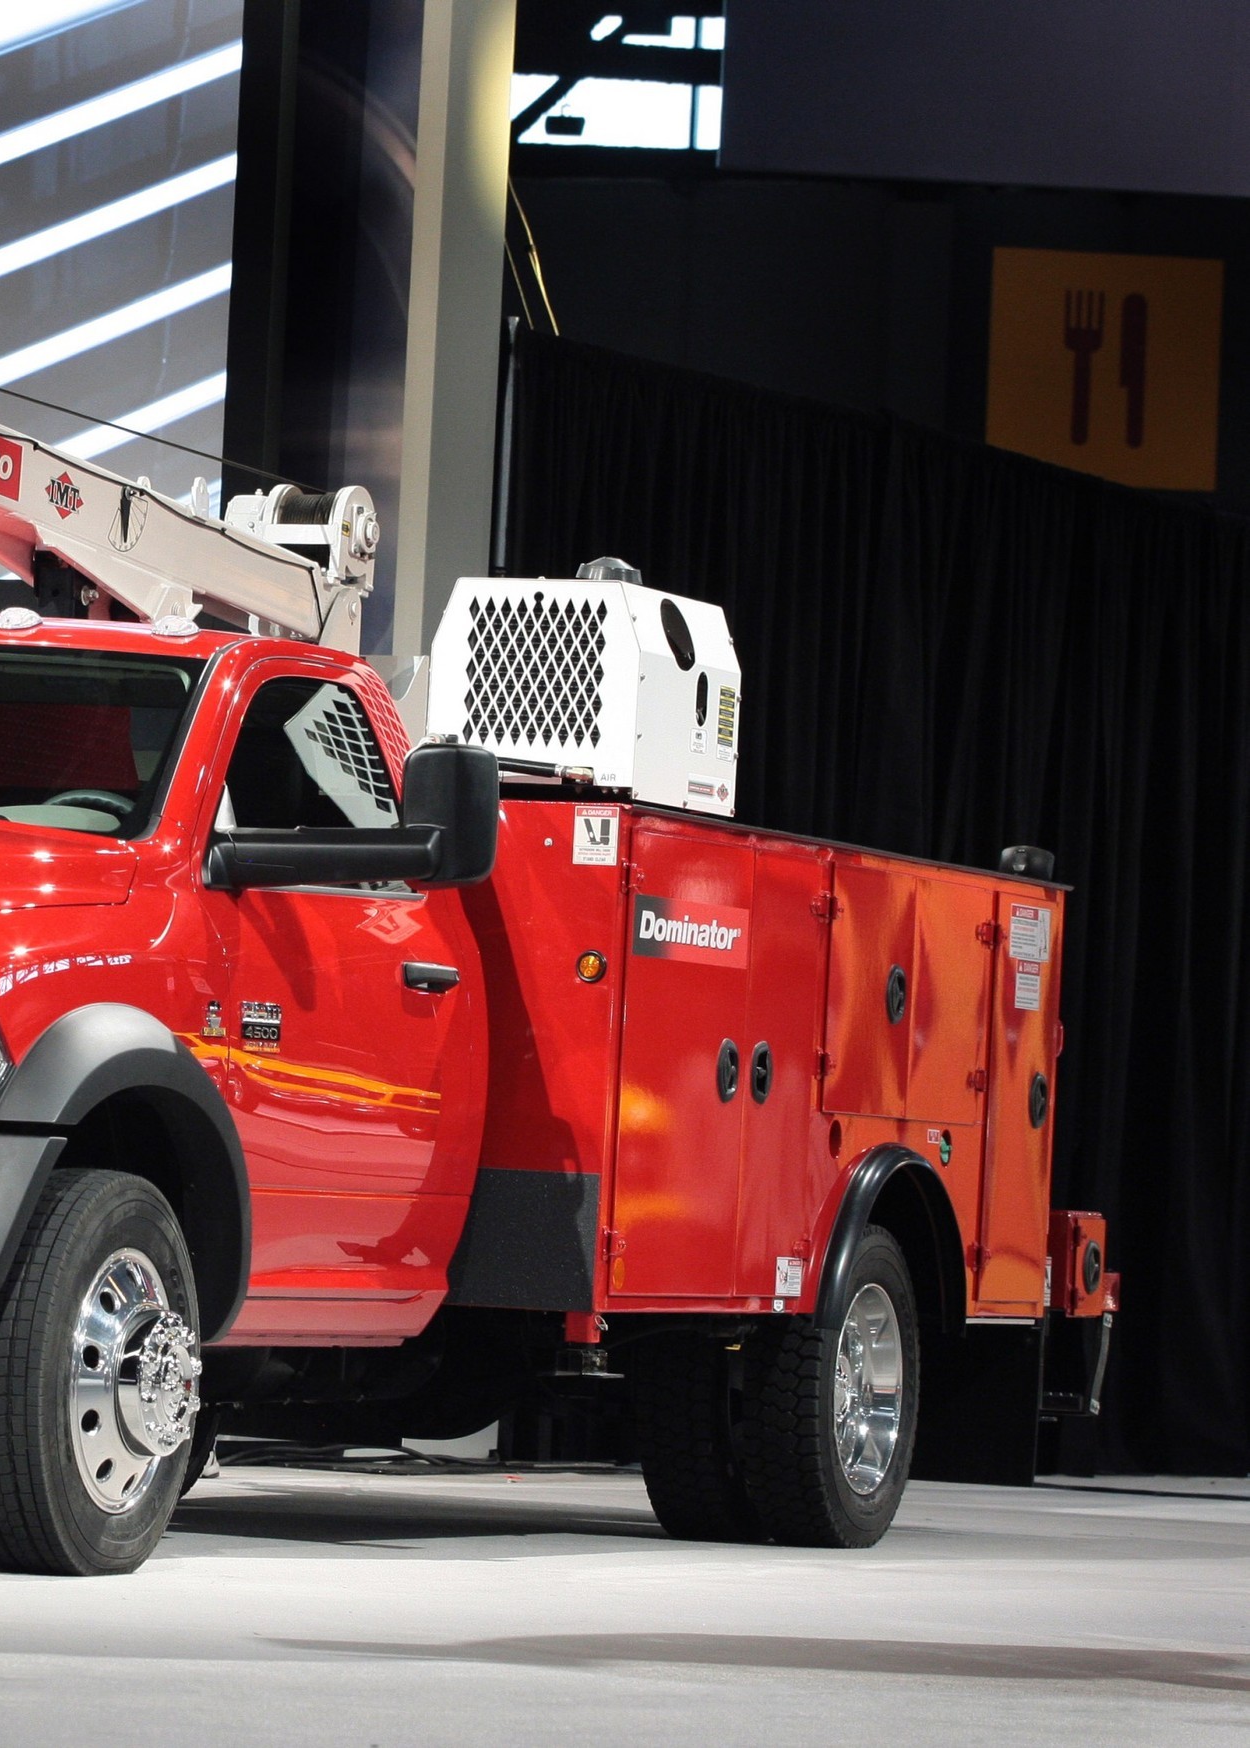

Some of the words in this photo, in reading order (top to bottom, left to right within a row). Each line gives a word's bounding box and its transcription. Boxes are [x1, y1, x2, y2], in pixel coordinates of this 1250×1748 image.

[48, 478, 81, 512] IMT
[600, 773, 616, 781] AIR
[587, 809, 613, 817] DANGER
[639, 910, 738, 950] Dominator
[244, 1025, 279, 1040] 4500
